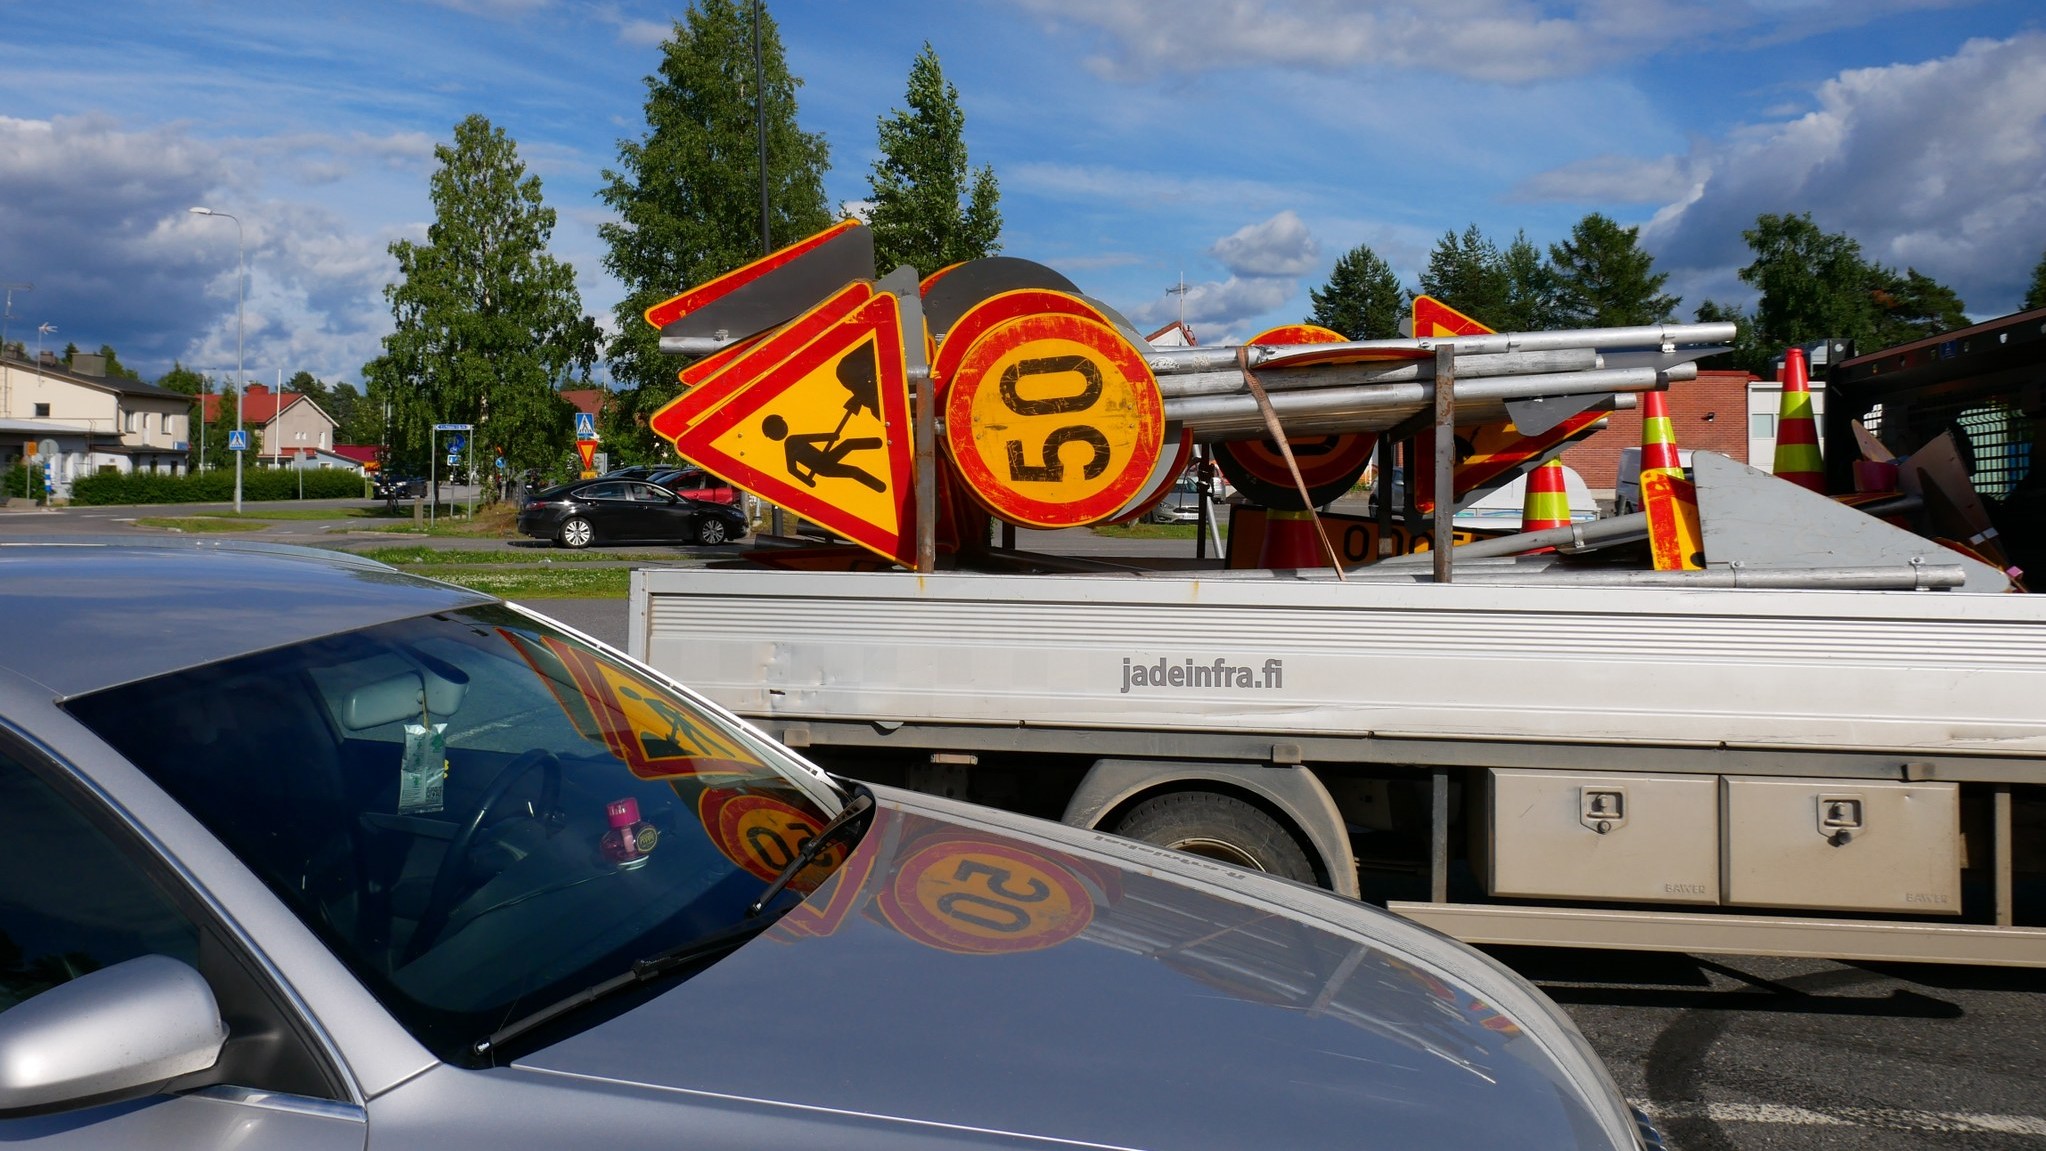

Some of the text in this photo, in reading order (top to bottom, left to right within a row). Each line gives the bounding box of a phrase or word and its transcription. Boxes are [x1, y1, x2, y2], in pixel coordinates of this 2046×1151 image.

[999, 354, 1111, 482] 50
[1120, 657, 1283, 694] jadeinfra.fi
[1664, 882, 1705, 894] BAWER
